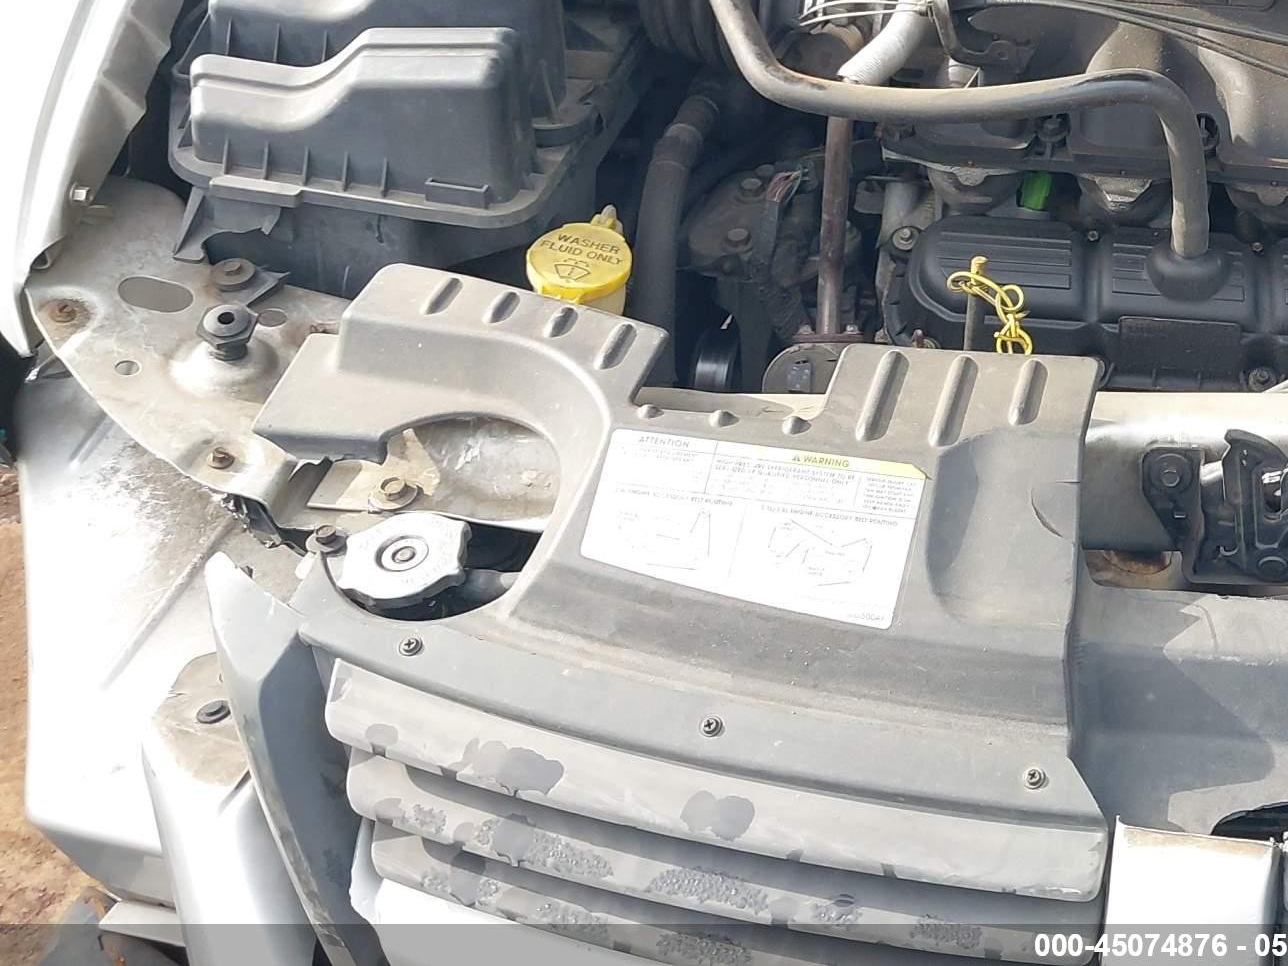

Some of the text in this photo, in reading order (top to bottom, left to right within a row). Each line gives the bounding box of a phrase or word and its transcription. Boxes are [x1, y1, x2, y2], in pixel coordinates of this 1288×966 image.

[540, 239, 623, 265] FLUID ONLY
[557, 234, 621, 255] WASHER
[638, 435, 690, 448] ATTENTION
[803, 454, 850, 468] WARNING
